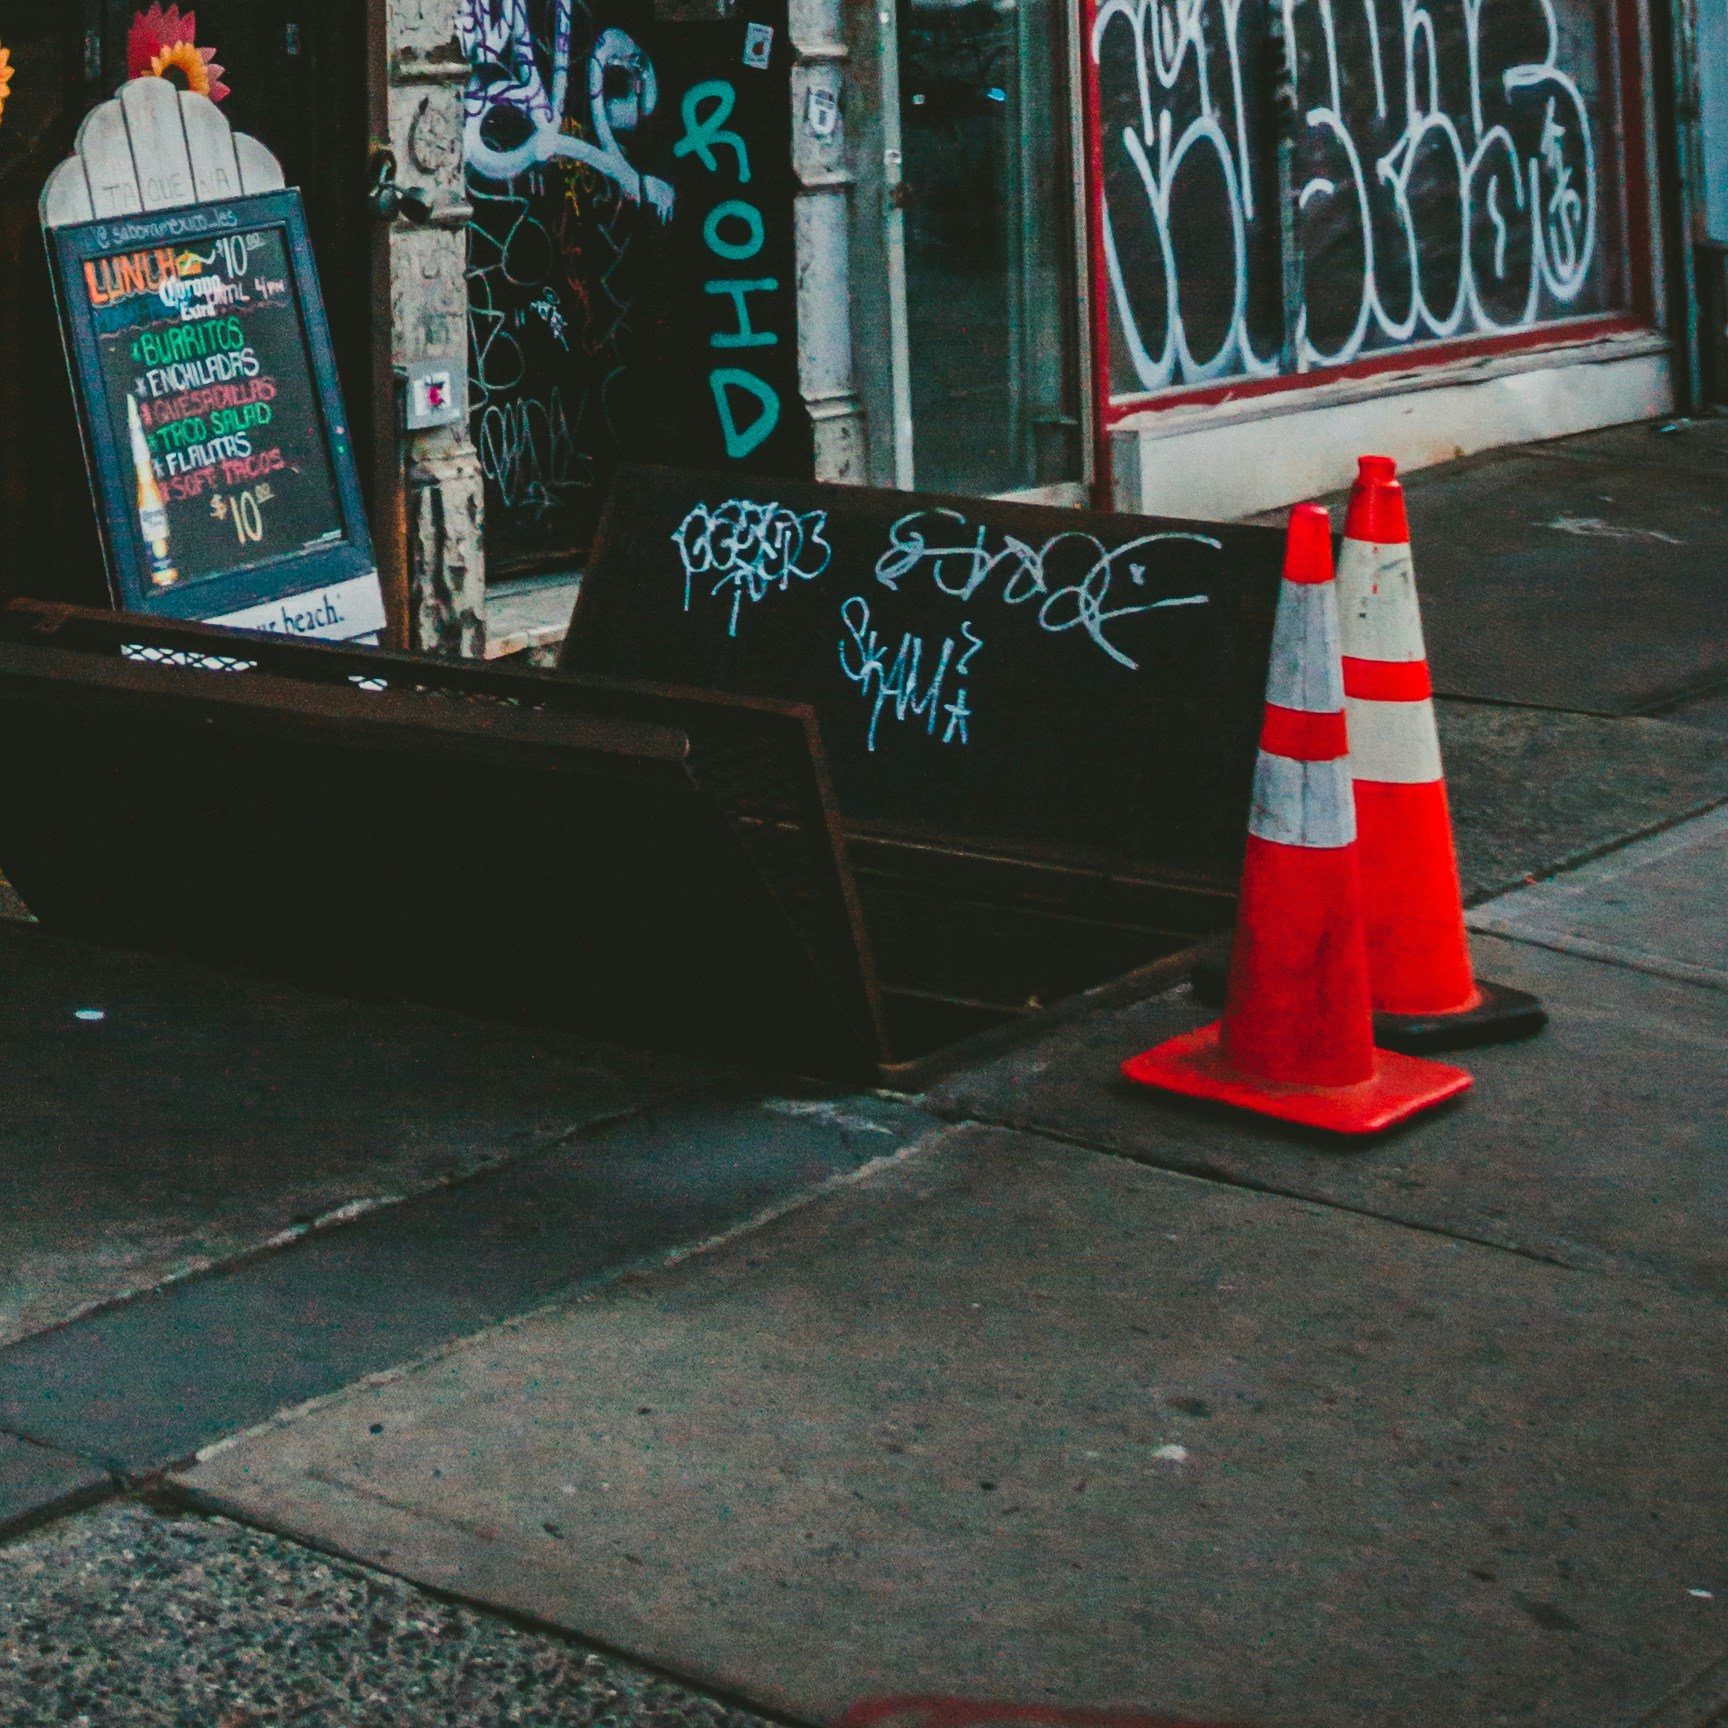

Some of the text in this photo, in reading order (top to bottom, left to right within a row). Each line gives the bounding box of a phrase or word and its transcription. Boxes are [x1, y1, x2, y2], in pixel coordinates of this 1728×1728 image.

[85, 247, 180, 305] LUNCH
[141, 316, 244, 366] BURRITOS
[146, 348, 259, 396] ENCHILADAS
[154, 376, 277, 421] QUESADILLAS
[157, 402, 272, 451] TACO SALAD
[166, 432, 252, 475] FLAUTAS
[172, 448, 285, 499] SOFT TACOS
